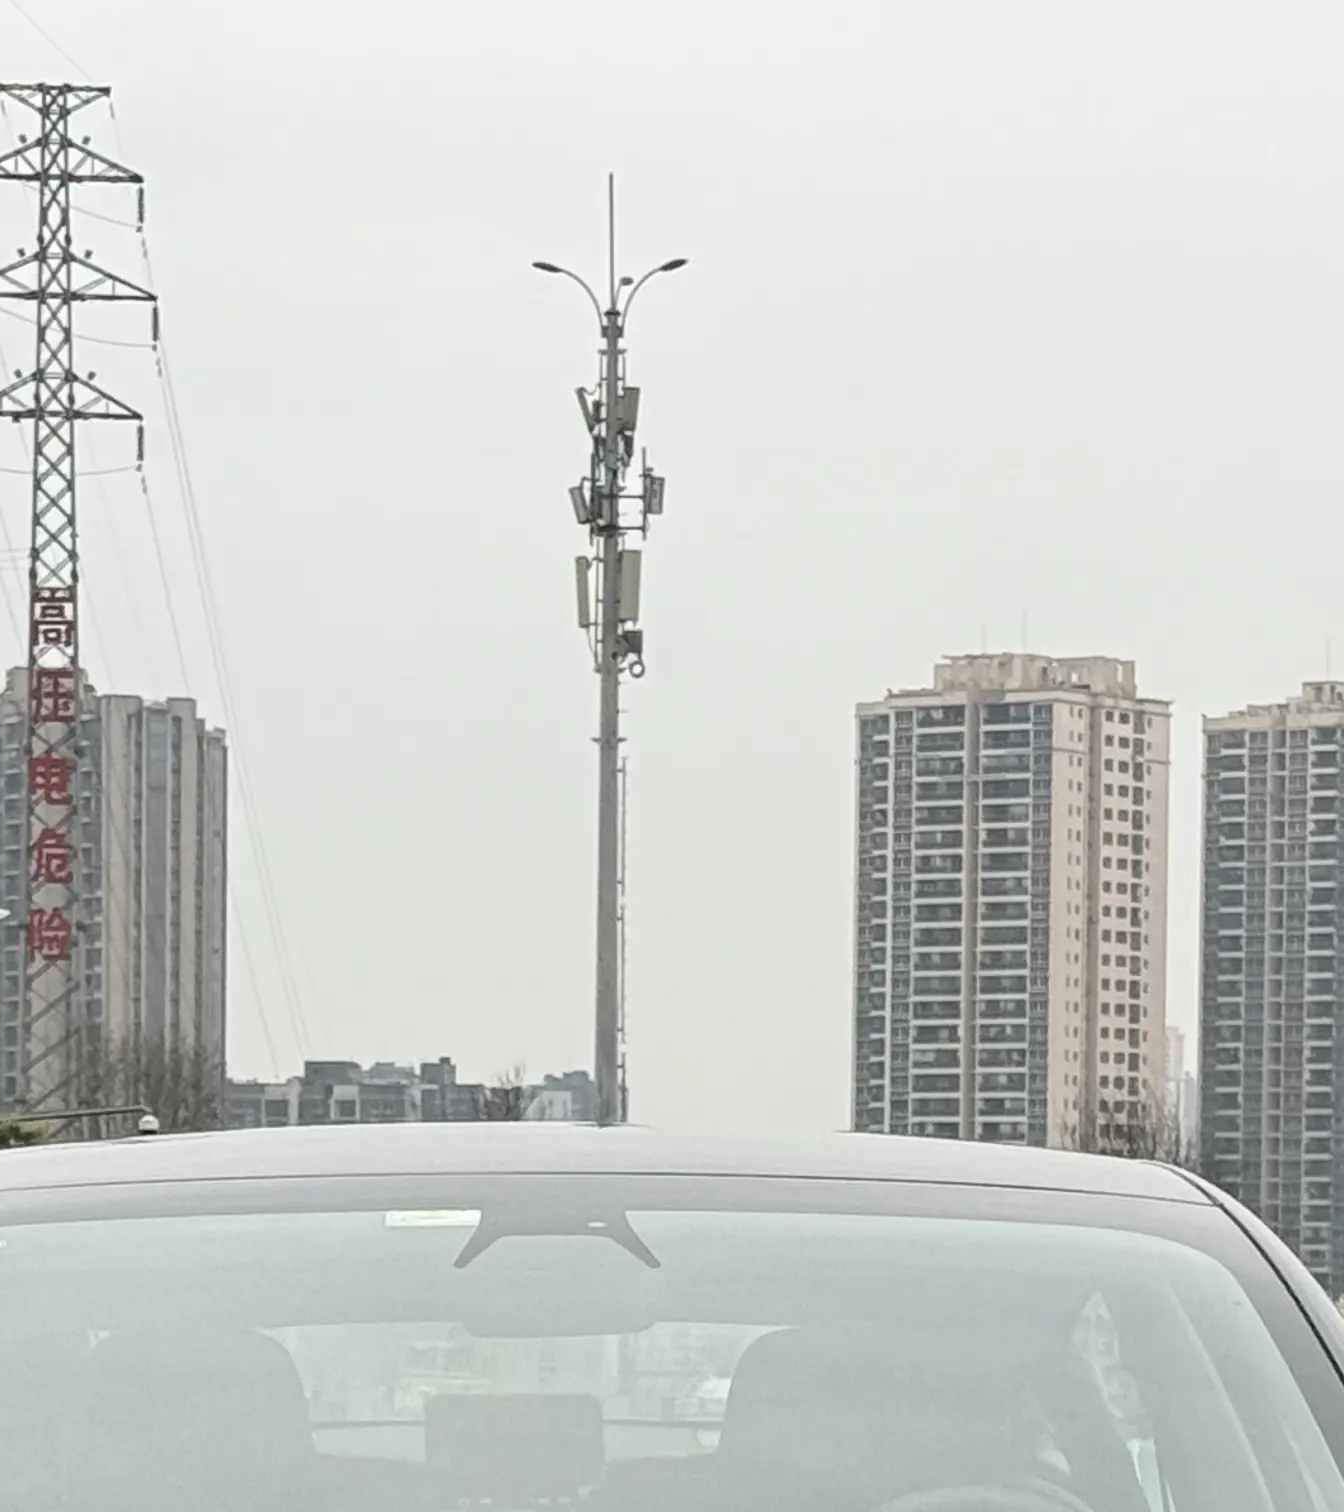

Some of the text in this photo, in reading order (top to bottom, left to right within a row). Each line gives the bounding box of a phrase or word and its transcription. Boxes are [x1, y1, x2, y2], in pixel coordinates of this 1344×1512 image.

[26, 586, 77, 961] 高压电危险
